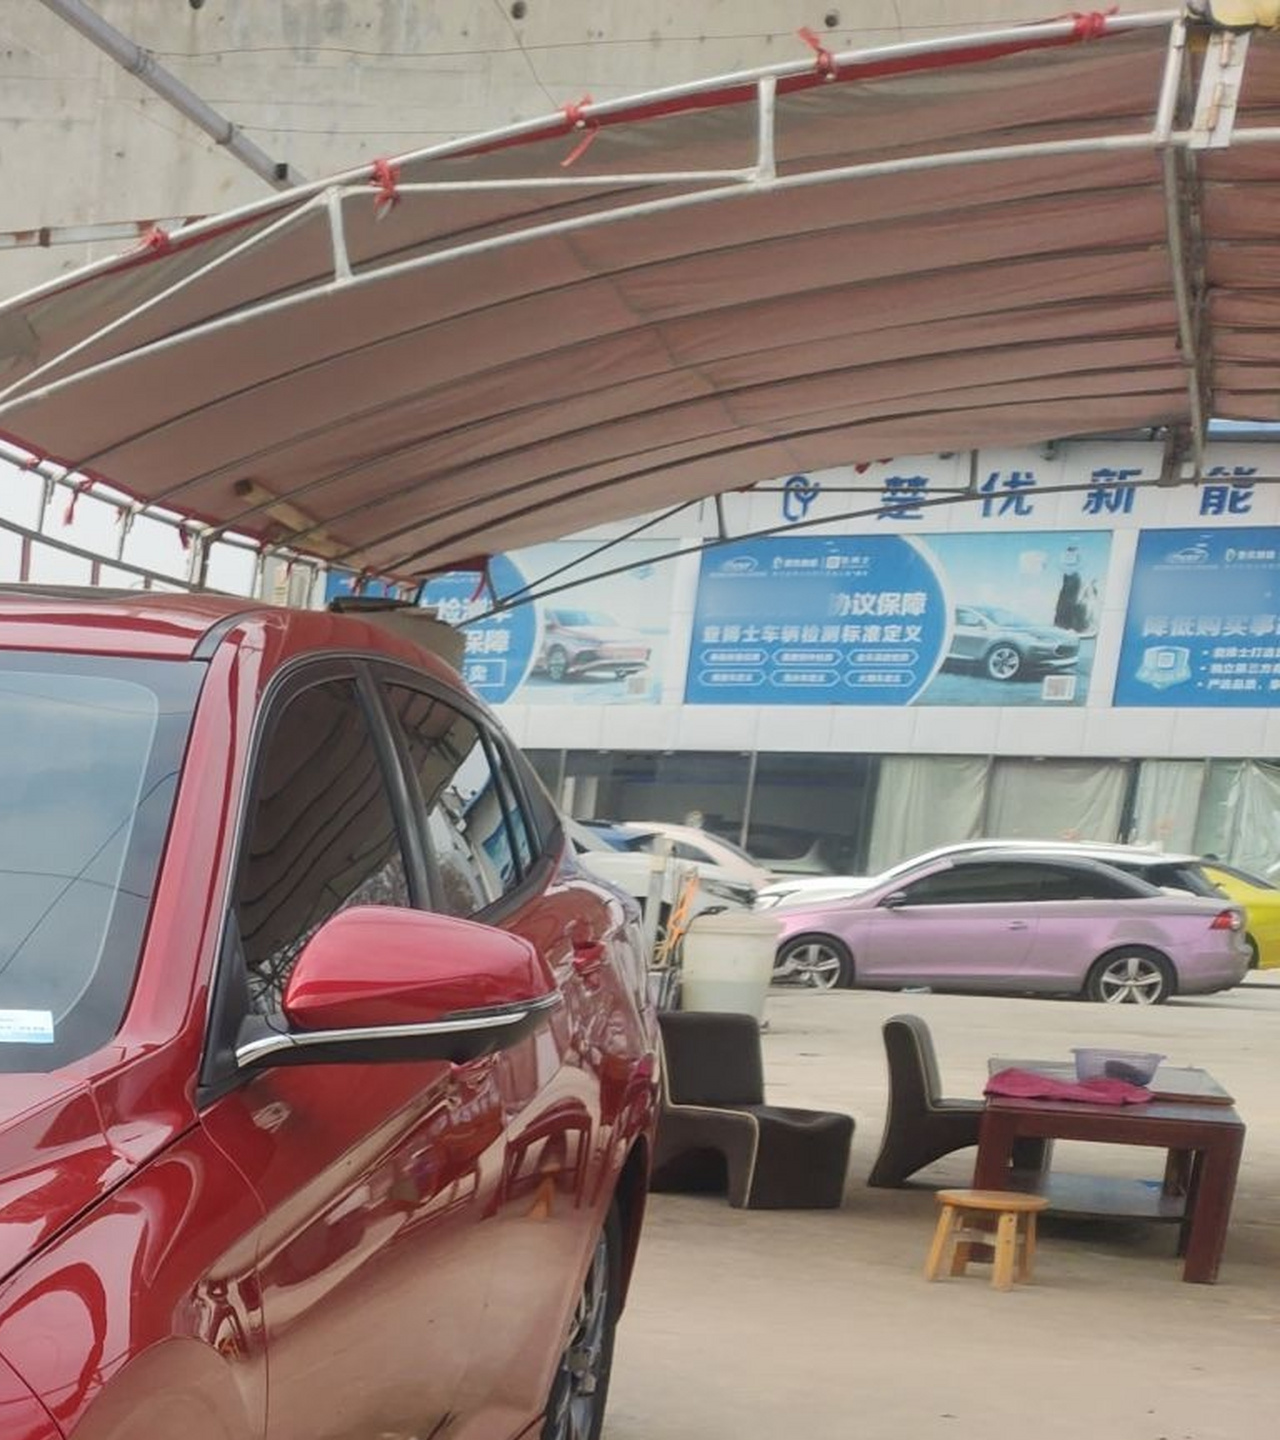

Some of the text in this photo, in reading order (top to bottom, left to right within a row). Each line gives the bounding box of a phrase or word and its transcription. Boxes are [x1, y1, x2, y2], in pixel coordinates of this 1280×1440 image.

[1141, 613, 1280, 638] 降低购买事
